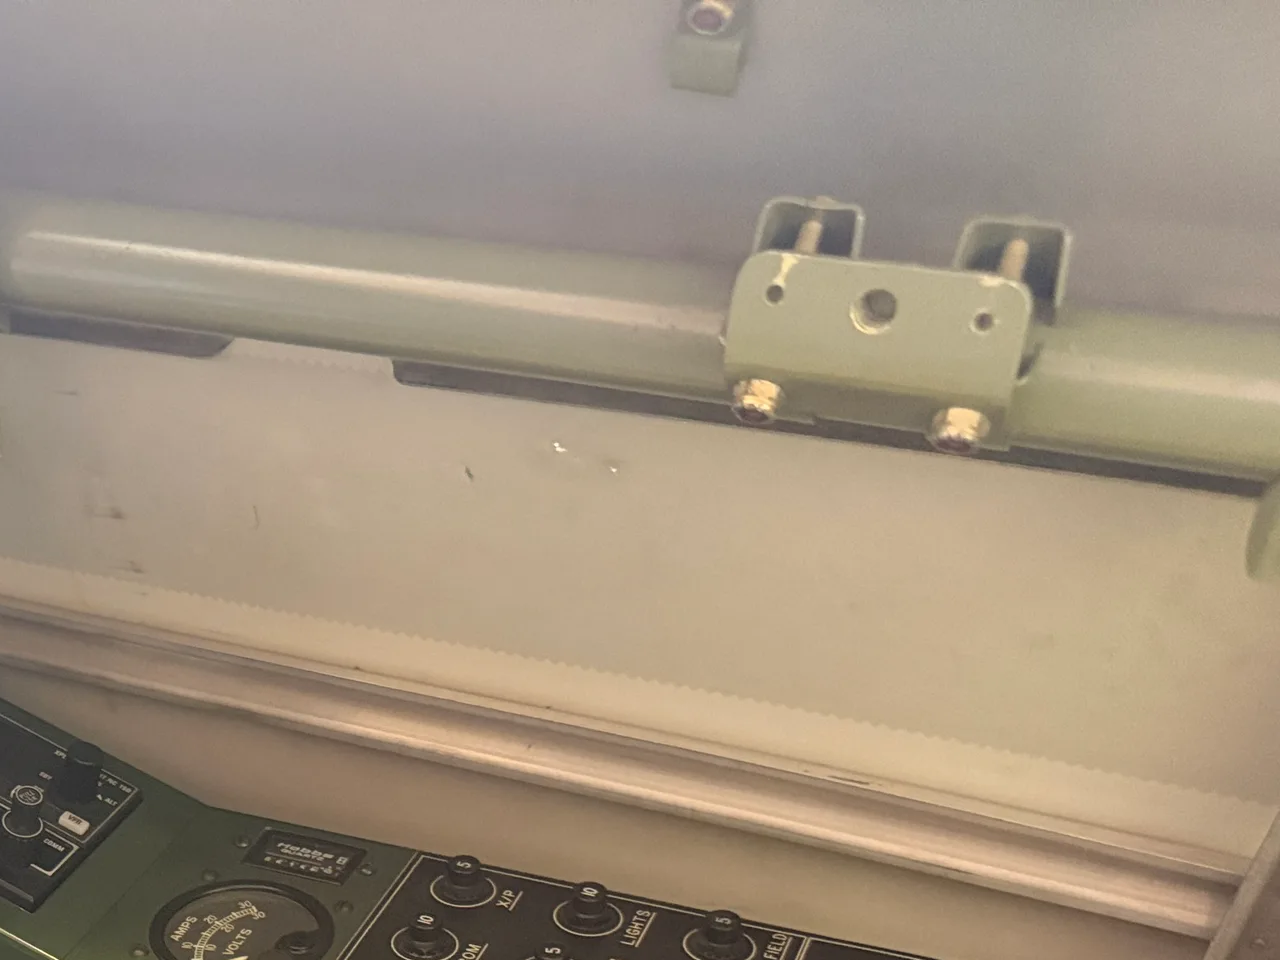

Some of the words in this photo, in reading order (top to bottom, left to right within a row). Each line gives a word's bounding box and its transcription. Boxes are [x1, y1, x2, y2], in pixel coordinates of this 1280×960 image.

[43, 838, 65, 852] COMM
[457, 860, 471, 869] 5
[580, 887, 598, 897] 10
[496, 889, 517, 909] X/P
[238, 900, 252, 909] 30
[203, 914, 218, 924] 20
[417, 914, 435, 925] 10
[715, 917, 732, 925] 5
[170, 915, 198, 942] AMPS
[221, 923, 235, 933] 20
[619, 909, 651, 946] LIGHTS
[222, 928, 252, 956] VOLTS
[763, 932, 788, 960] FIELD
[545, 947, 561, 955] 5
